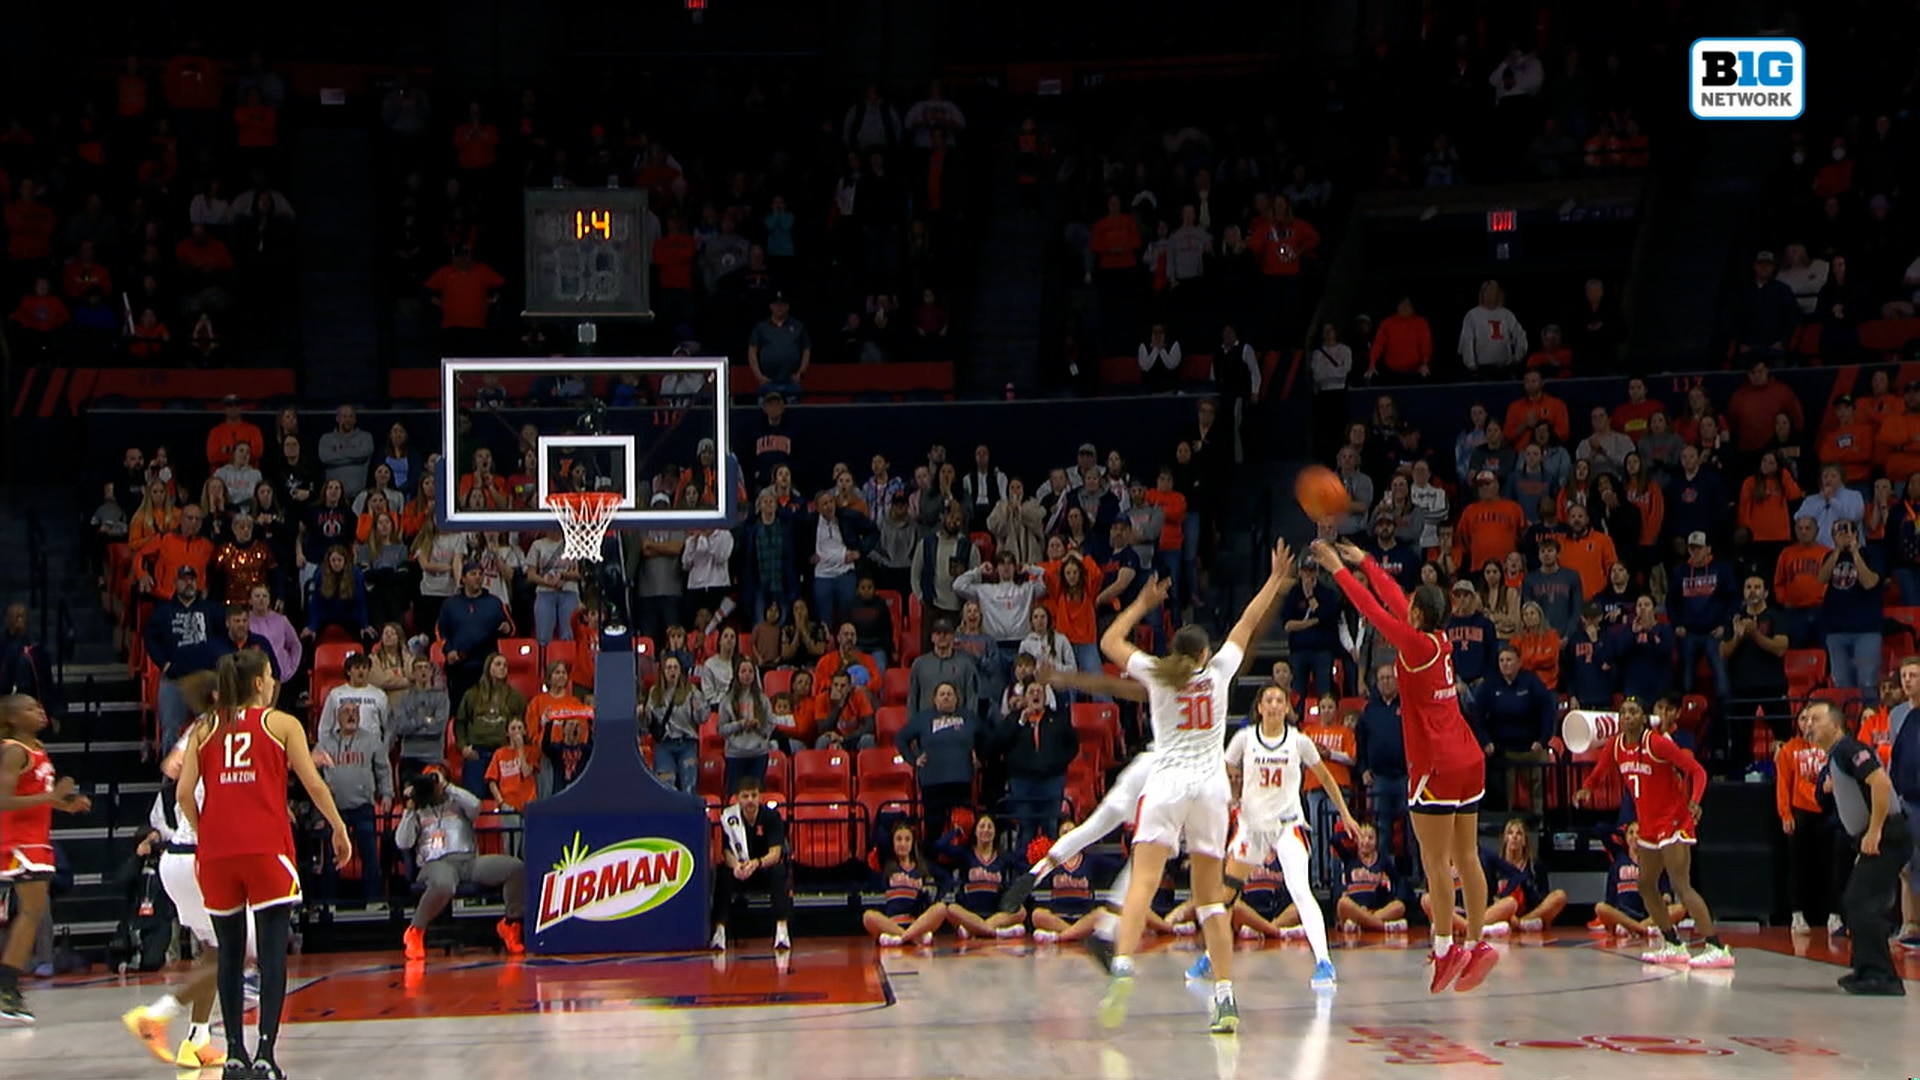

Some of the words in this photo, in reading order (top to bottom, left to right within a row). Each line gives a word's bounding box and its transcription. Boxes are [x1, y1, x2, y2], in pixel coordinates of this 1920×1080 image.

[576, 209, 611, 240] 1.4
[1176, 696, 1213, 730] 30
[224, 732, 252, 768] 12
[219, 771, 257, 784] GARZON
[1259, 768, 1282, 787] 34
[1628, 774, 1640, 798] 7
[539, 850, 681, 926] LIBMAN
